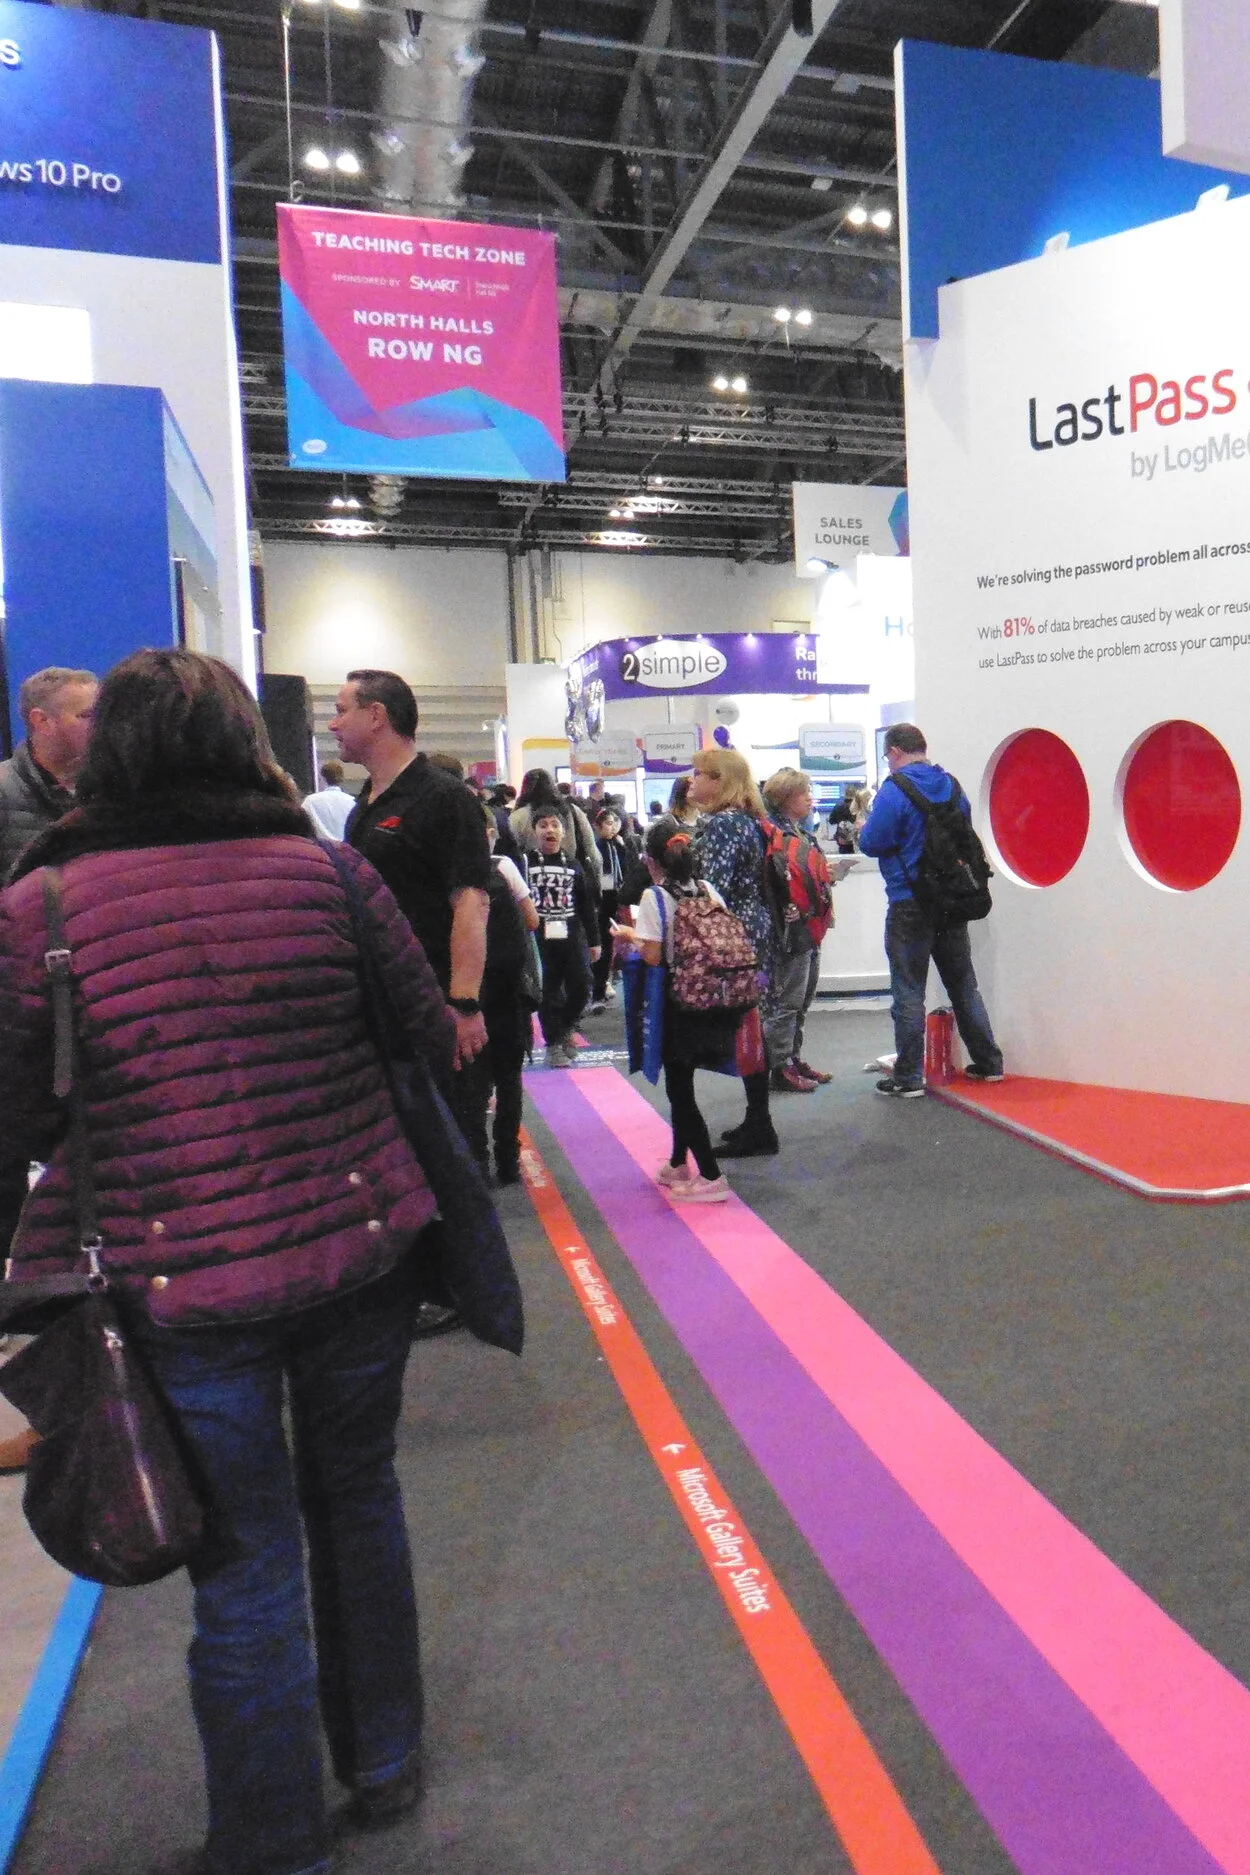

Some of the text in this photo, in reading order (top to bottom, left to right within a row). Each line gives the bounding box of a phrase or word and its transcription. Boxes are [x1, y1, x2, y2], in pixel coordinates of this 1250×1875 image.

[36, 158, 66, 186] 10
[72, 162, 122, 192] Pro
[311, 231, 526, 266] TEACHING TECH ZONE
[332, 273, 401, 287] SPONSORED BY
[409, 275, 460, 293] SMART
[353, 310, 494, 335] NORTH HALLS
[368, 337, 483, 366] ROW NG
[1131, 451, 1158, 480] by
[820, 517, 863, 530] SALES
[815, 534, 870, 547] LOUNGE
[1011, 569, 1051, 584] solving
[1053, 565, 1073, 579] the
[1075, 555, 1133, 579] password
[1136, 550, 1190, 571] problem
[1192, 545, 1208, 560] all
[978, 626, 1002, 640] With
[1003, 617, 1036, 638] 81%
[1037, 620, 1049, 634] of
[1050, 618, 1070, 633] data
[1073, 613, 1118, 631] breaches
[1120, 608, 1156, 626] caused
[1159, 607, 1172, 626] by
[1174, 603, 1204, 619] weak
[1207, 604, 1221, 616] or
[979, 658, 994, 669] use
[997, 652, 1035, 667] LastPass
[1037, 653, 1048, 664] to
[1050, 648, 1075, 663] solve
[1077, 646, 1094, 660] the
[1097, 641, 1140, 662] problem
[1143, 639, 1177, 654] across
[1180, 638, 1206, 655] your
[676, 1467, 771, 1613] Microsoft Gallery Suites
